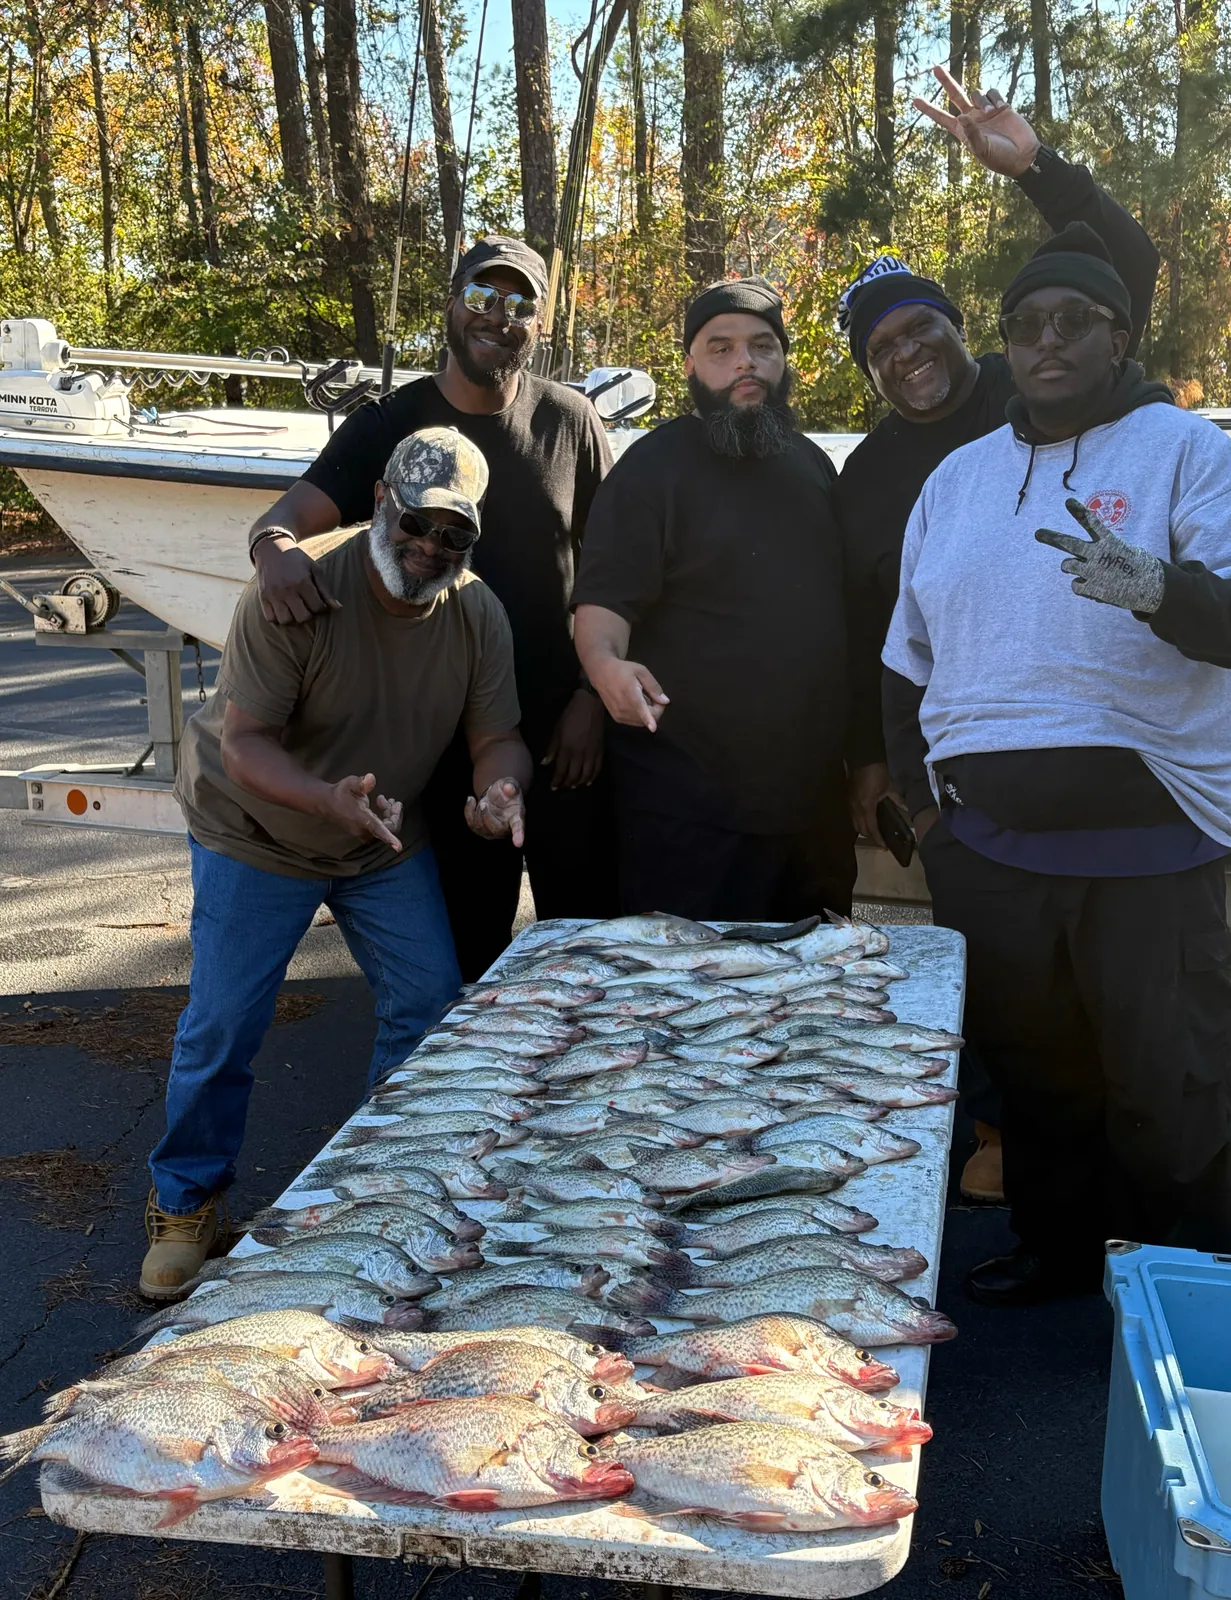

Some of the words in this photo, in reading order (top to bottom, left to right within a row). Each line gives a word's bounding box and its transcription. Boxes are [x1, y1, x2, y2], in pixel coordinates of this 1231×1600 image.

[0, 394, 26, 404] MINN
[29, 396, 57, 406] KOTA
[29, 405, 58, 413] TERROVA
[1098, 552, 1136, 577] HyFlex
